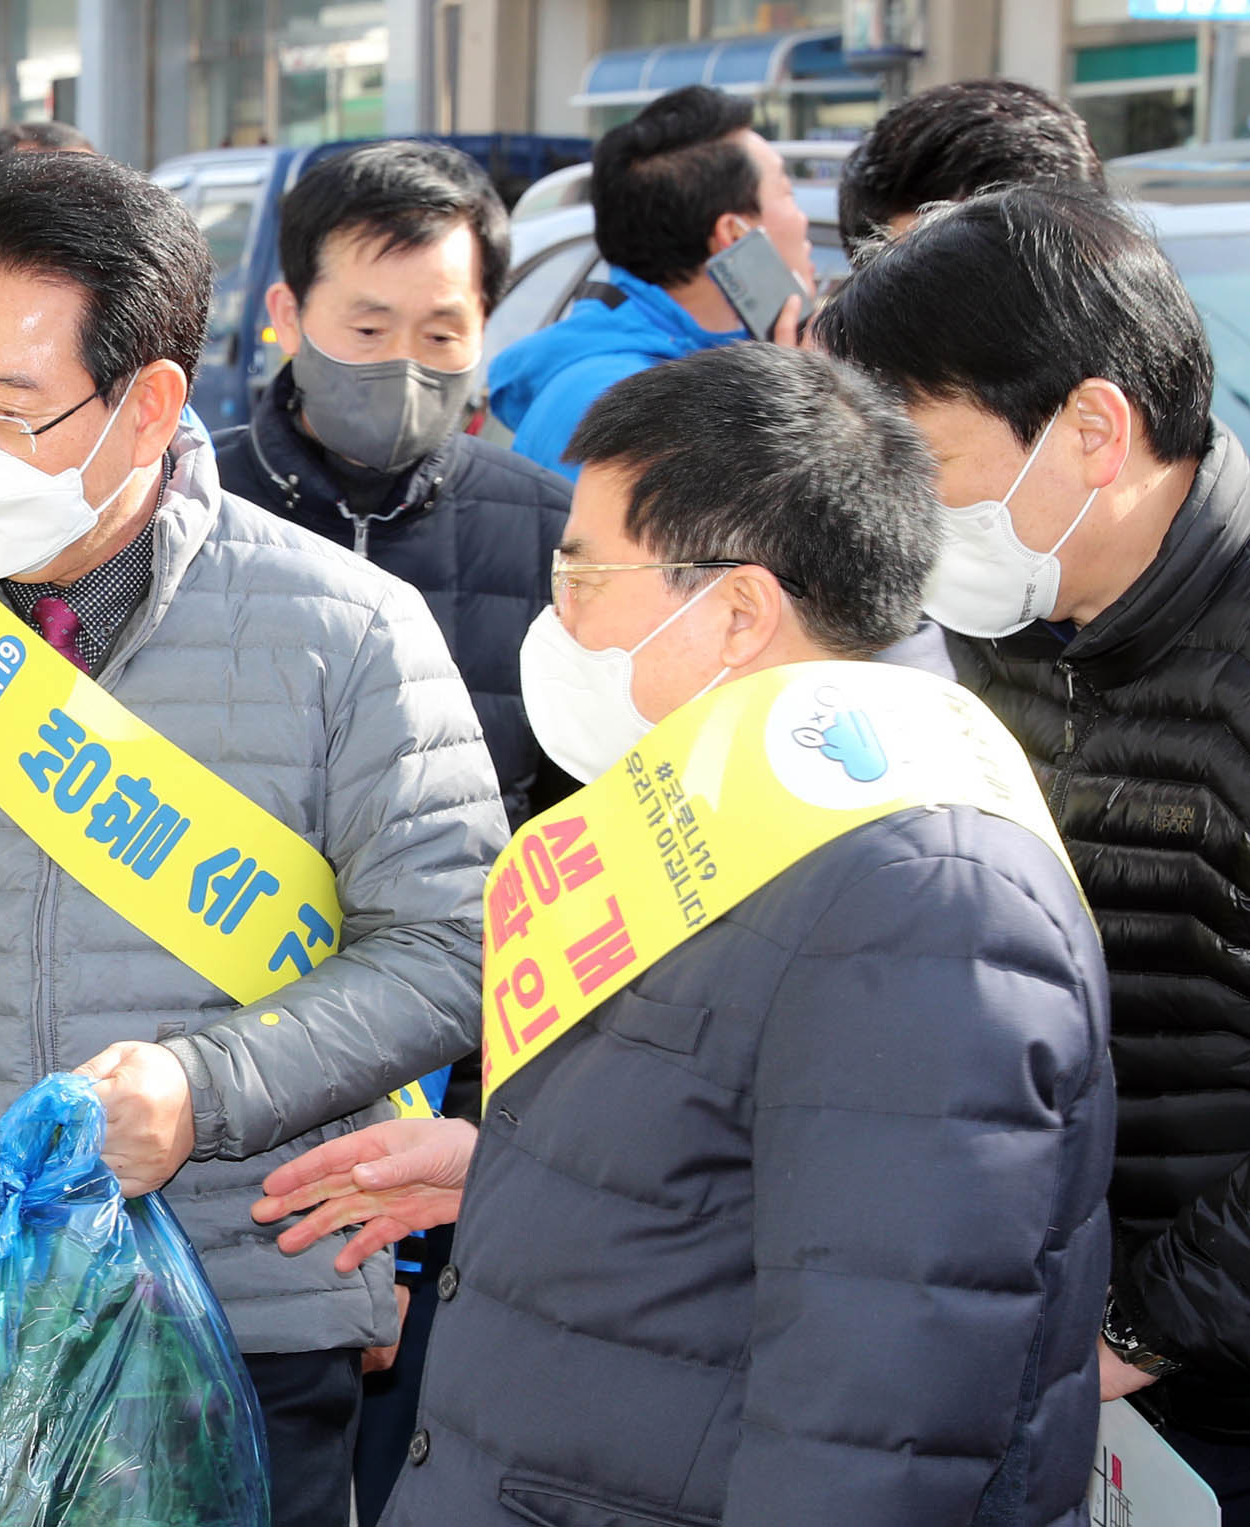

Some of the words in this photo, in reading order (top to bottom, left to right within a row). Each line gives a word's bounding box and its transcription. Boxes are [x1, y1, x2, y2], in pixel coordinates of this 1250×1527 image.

[18, 708, 191, 881] 생활
[187, 847, 280, 934] 속
[625, 751, 666, 829] 우리가
[656, 827, 708, 929] 이깁니다
[655, 761, 718, 881] #코로나19
[494, 894, 638, 1057] 개인
